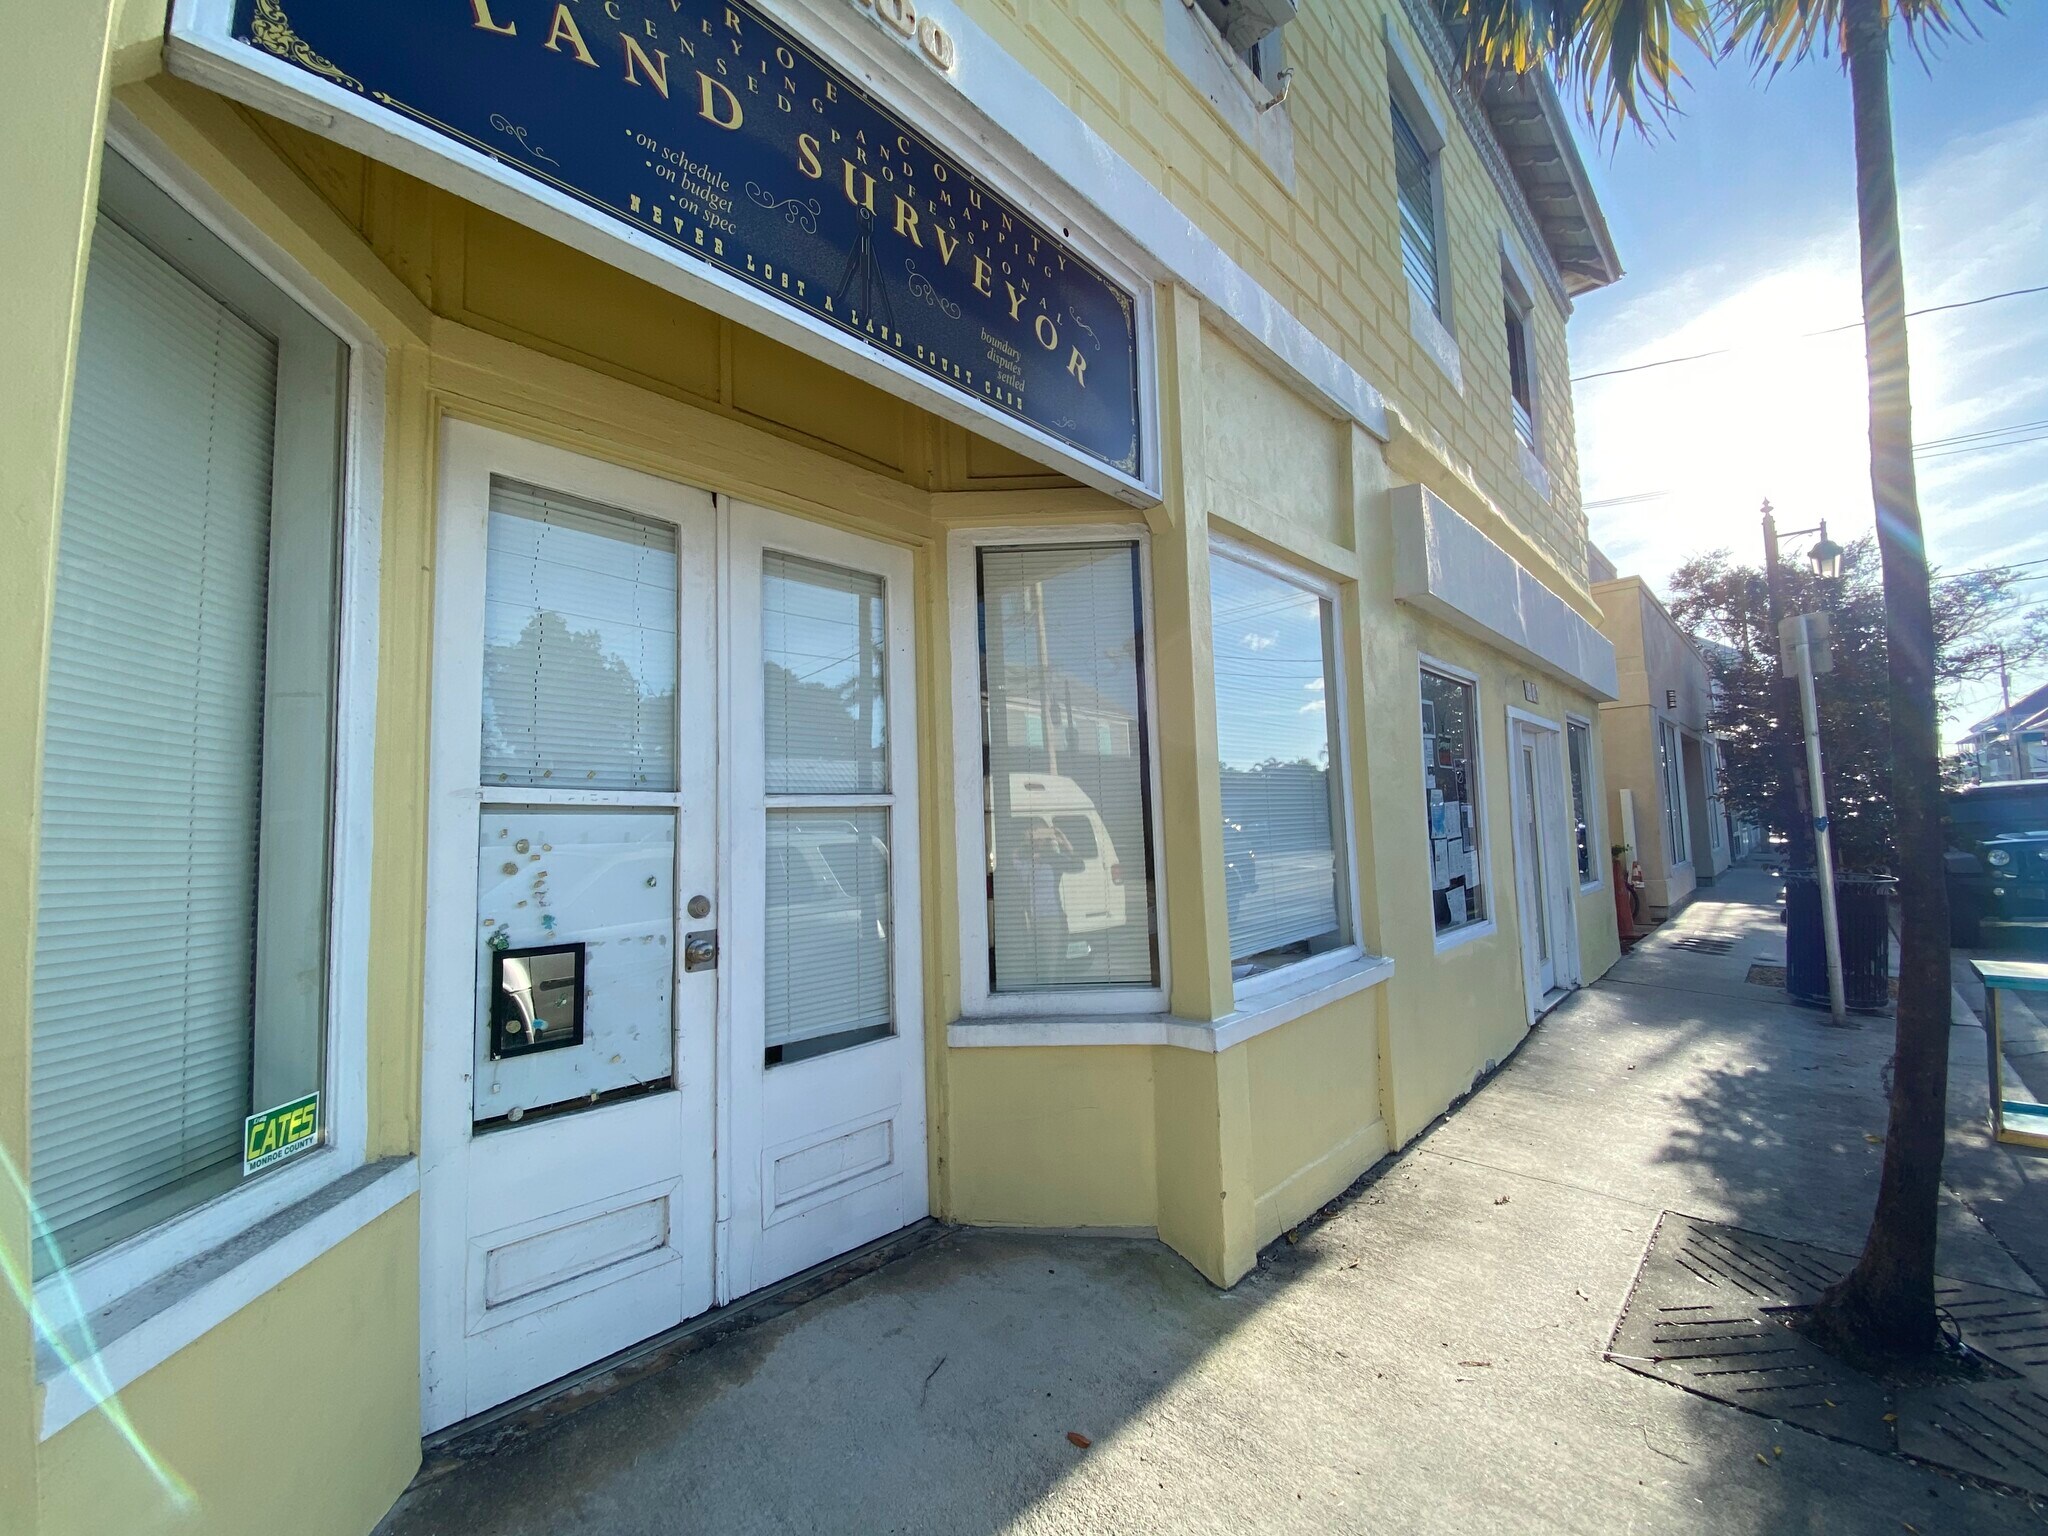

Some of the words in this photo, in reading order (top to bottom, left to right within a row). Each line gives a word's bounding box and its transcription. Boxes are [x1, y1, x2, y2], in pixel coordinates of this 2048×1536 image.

[858, 0, 954, 72] 00
[572, 0, 793, 113] CENSED
[831, 128, 1063, 327] PROFESSIONAL
[661, 147, 730, 192] schedule
[471, 0, 744, 130] LAND
[797, 133, 1088, 388] SURVEYOR
[681, 171, 734, 214] budget
[856, 129, 914, 178] AND
[940, 189, 1052, 279] MAPPING
[897, 136, 1068, 272] COUNTY
[702, 208, 737, 236] spec
[630, 193, 724, 256] NEVER
[747, 254, 806, 297] LOST
[824, 296, 834, 312] A
[851, 309, 902, 348] LAND
[917, 345, 972, 384] COURT
[985, 381, 1023, 411] CASE
[980, 327, 1022, 362] boundary
[987, 347, 1022, 376] disputes
[997, 368, 1025, 392] settled
[248, 1102, 316, 1160] CATES
[249, 1149, 283, 1171] MONROE
[284, 1136, 314, 1155] COUNTY
